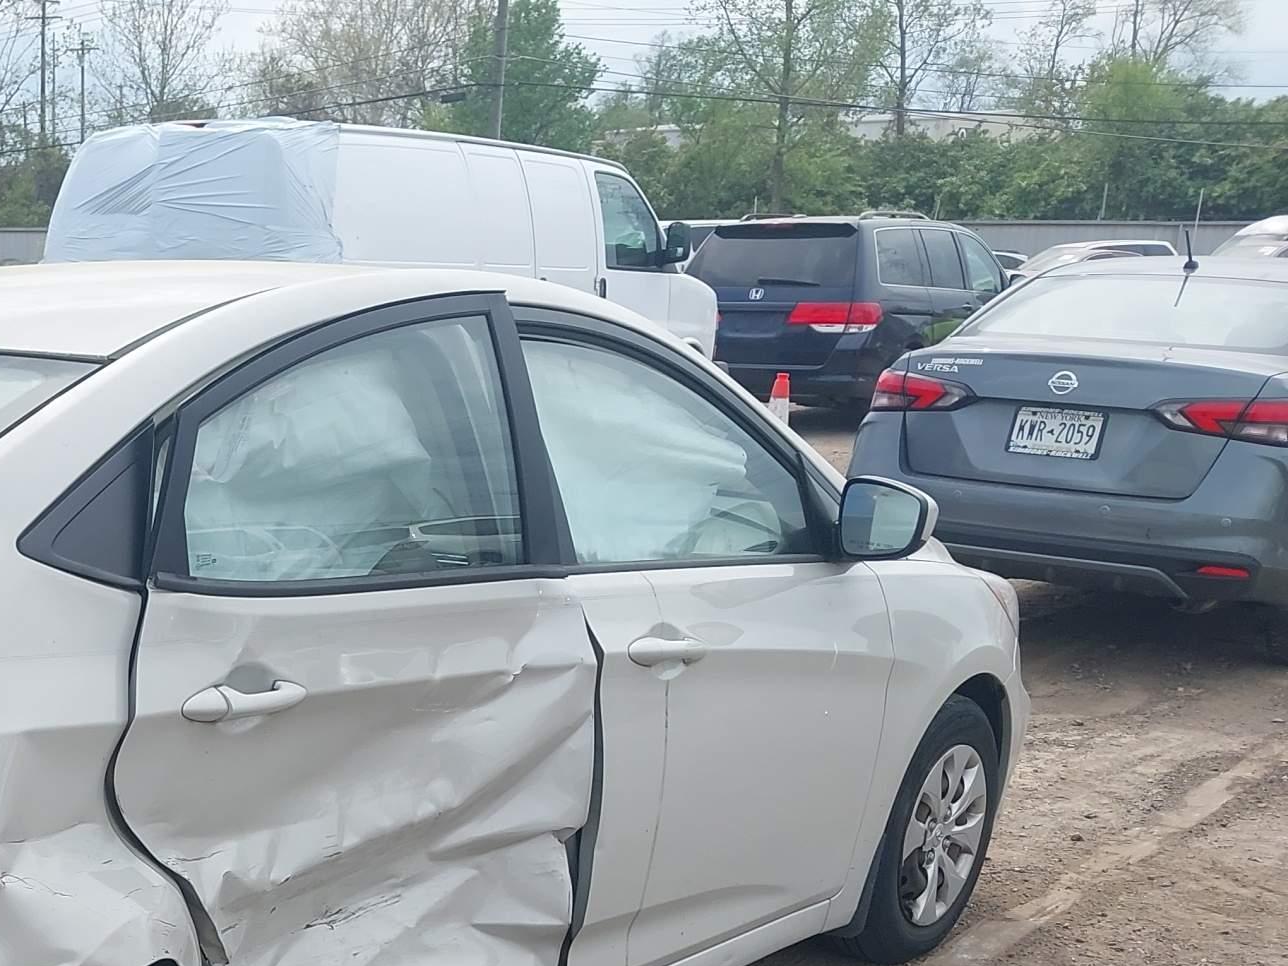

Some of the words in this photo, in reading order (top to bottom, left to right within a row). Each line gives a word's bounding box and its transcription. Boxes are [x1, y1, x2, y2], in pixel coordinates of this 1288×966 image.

[917, 362, 959, 373] VERSA
[1038, 411, 1057, 420] NEW
[1062, 412, 1082, 422] YORK
[1055, 422, 1096, 445] 2059
